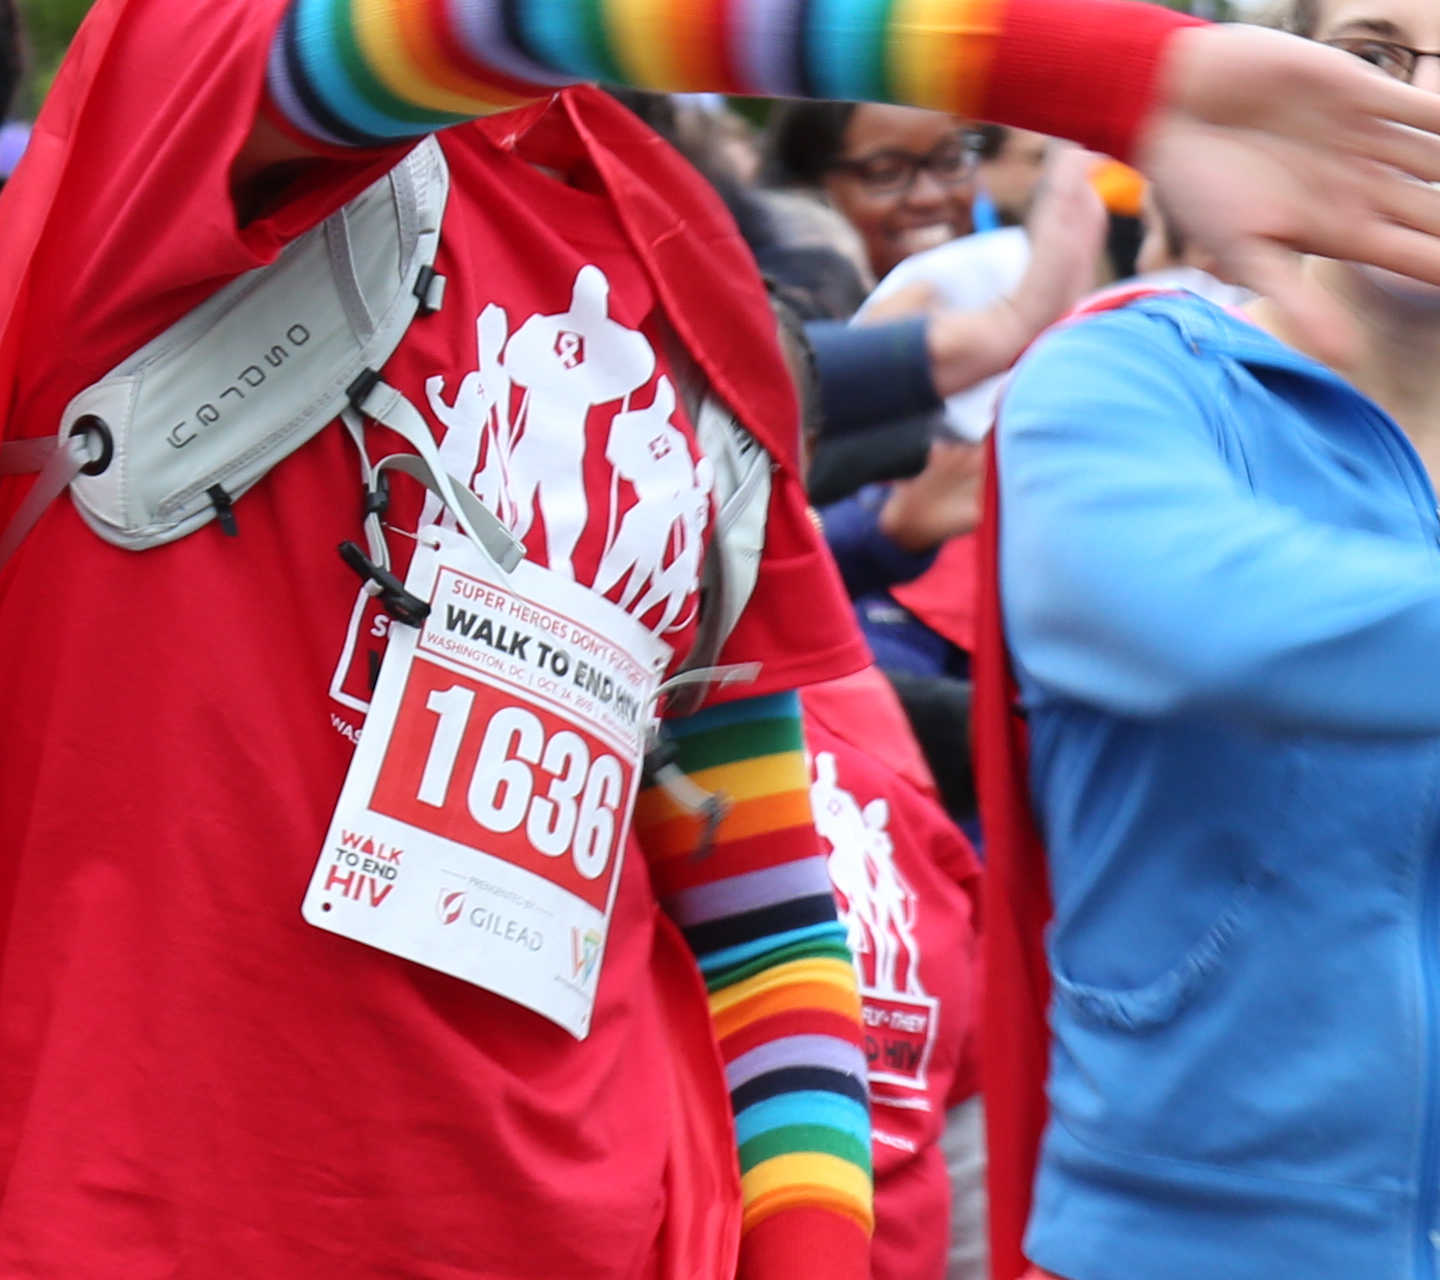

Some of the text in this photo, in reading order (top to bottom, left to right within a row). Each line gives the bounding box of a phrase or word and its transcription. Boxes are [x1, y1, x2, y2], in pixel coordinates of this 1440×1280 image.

[451, 579, 506, 610] SUPER
[509, 601, 569, 640] HEROES
[444, 602, 533, 662] WALK
[536, 640, 571, 677] TO
[573, 659, 614, 704] END
[509, 664, 526, 681] DC
[416, 684, 623, 880] 1636
[323, 864, 393, 908] HIV
[335, 847, 398, 881] TO END
[468, 907, 544, 952] GILEAD
